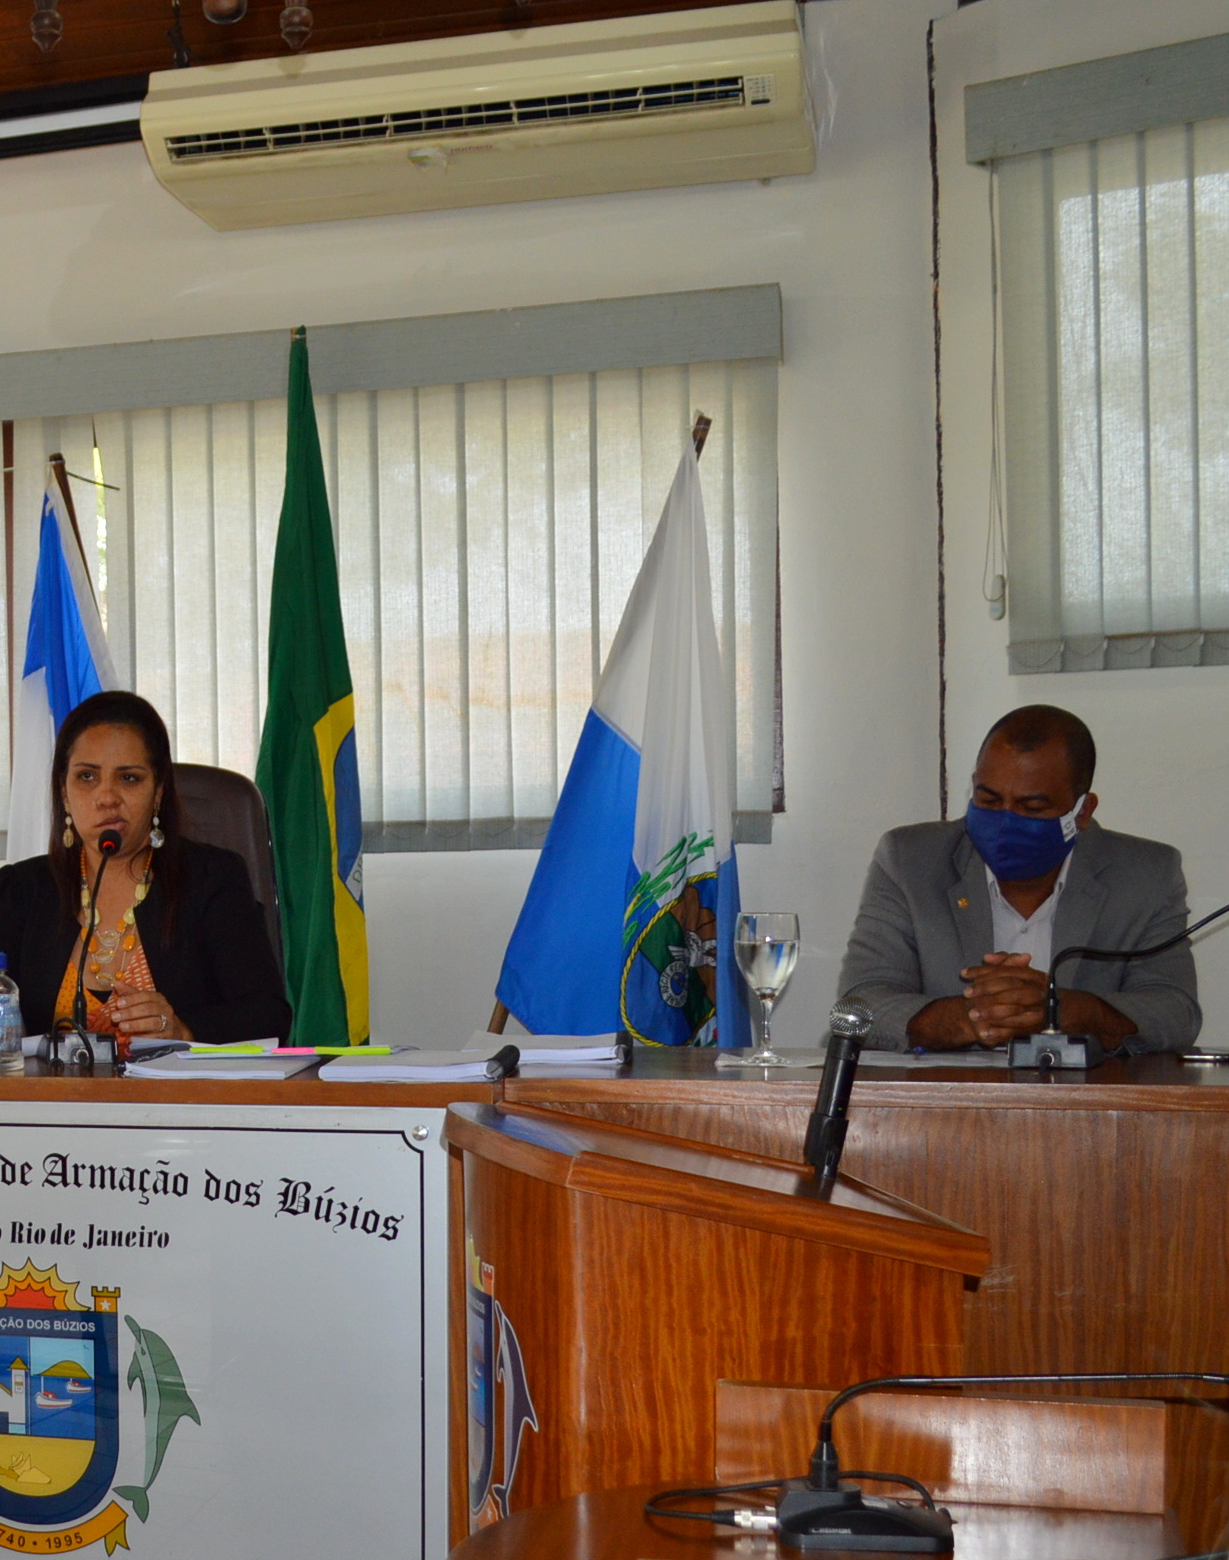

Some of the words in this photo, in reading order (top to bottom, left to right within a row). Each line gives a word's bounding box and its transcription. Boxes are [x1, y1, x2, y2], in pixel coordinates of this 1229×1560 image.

[0, 1154, 33, 1187] de
[41, 1152, 189, 1205] Armação
[203, 1168, 264, 1208] dos
[274, 1177, 405, 1242] Búzios
[10, 1221, 46, 1245] Rio
[50, 1222, 76, 1246] de
[83, 1223, 170, 1250] Janeiro
[26, 1319, 51, 1331] DOS
[53, 1319, 96, 1333] BÚZIOS
[45, 1532, 83, 1549] 1995
